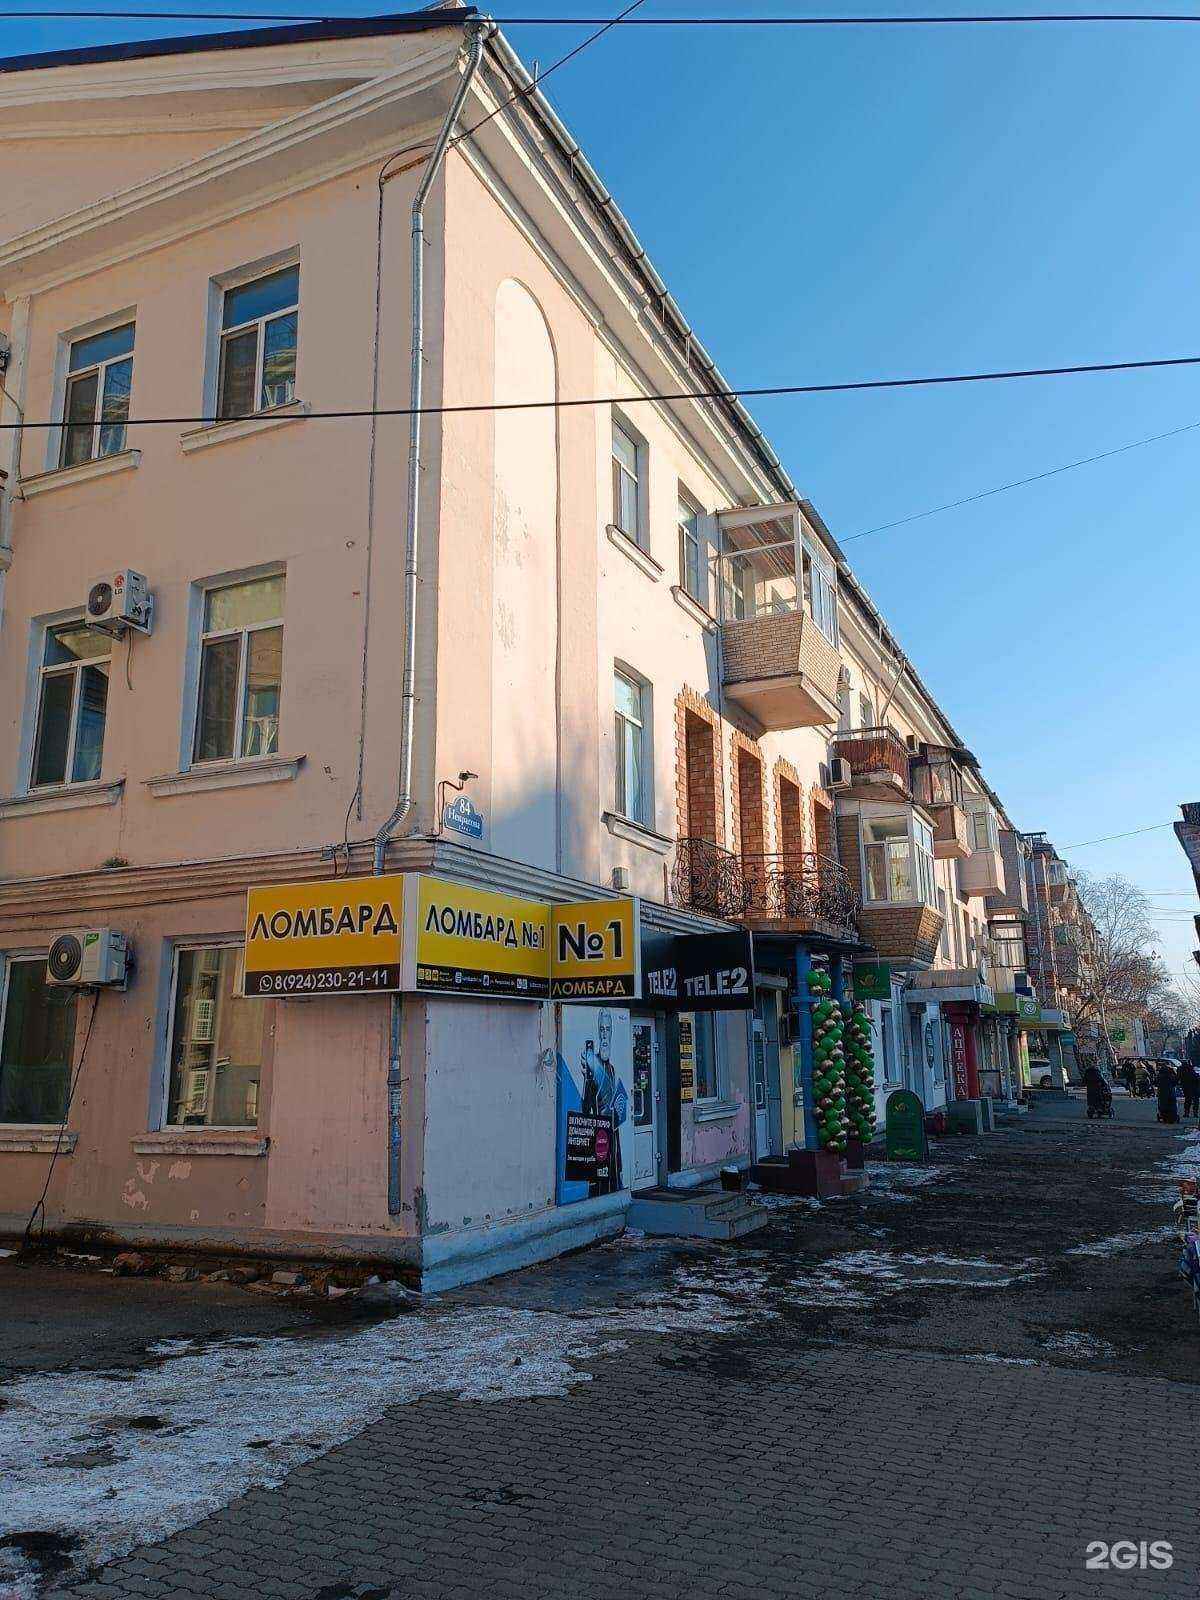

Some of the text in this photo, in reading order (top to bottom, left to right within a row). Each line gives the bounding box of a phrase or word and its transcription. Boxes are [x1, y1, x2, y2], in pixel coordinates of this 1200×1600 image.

[460, 798, 470, 816] 84
[250, 903, 398, 941] ЛОМБАРД
[425, 903, 545, 950] ЛОМБАРД №1
[557, 919, 624, 962] №1
[274, 969, 389, 991] 8(924)230-21-11
[552, 978, 626, 997] ЛОМБАРД
[648, 967, 677, 996] TELE2
[684, 966, 749, 997] TELE2
[953, 1027, 967, 1097] АПТЕКА
